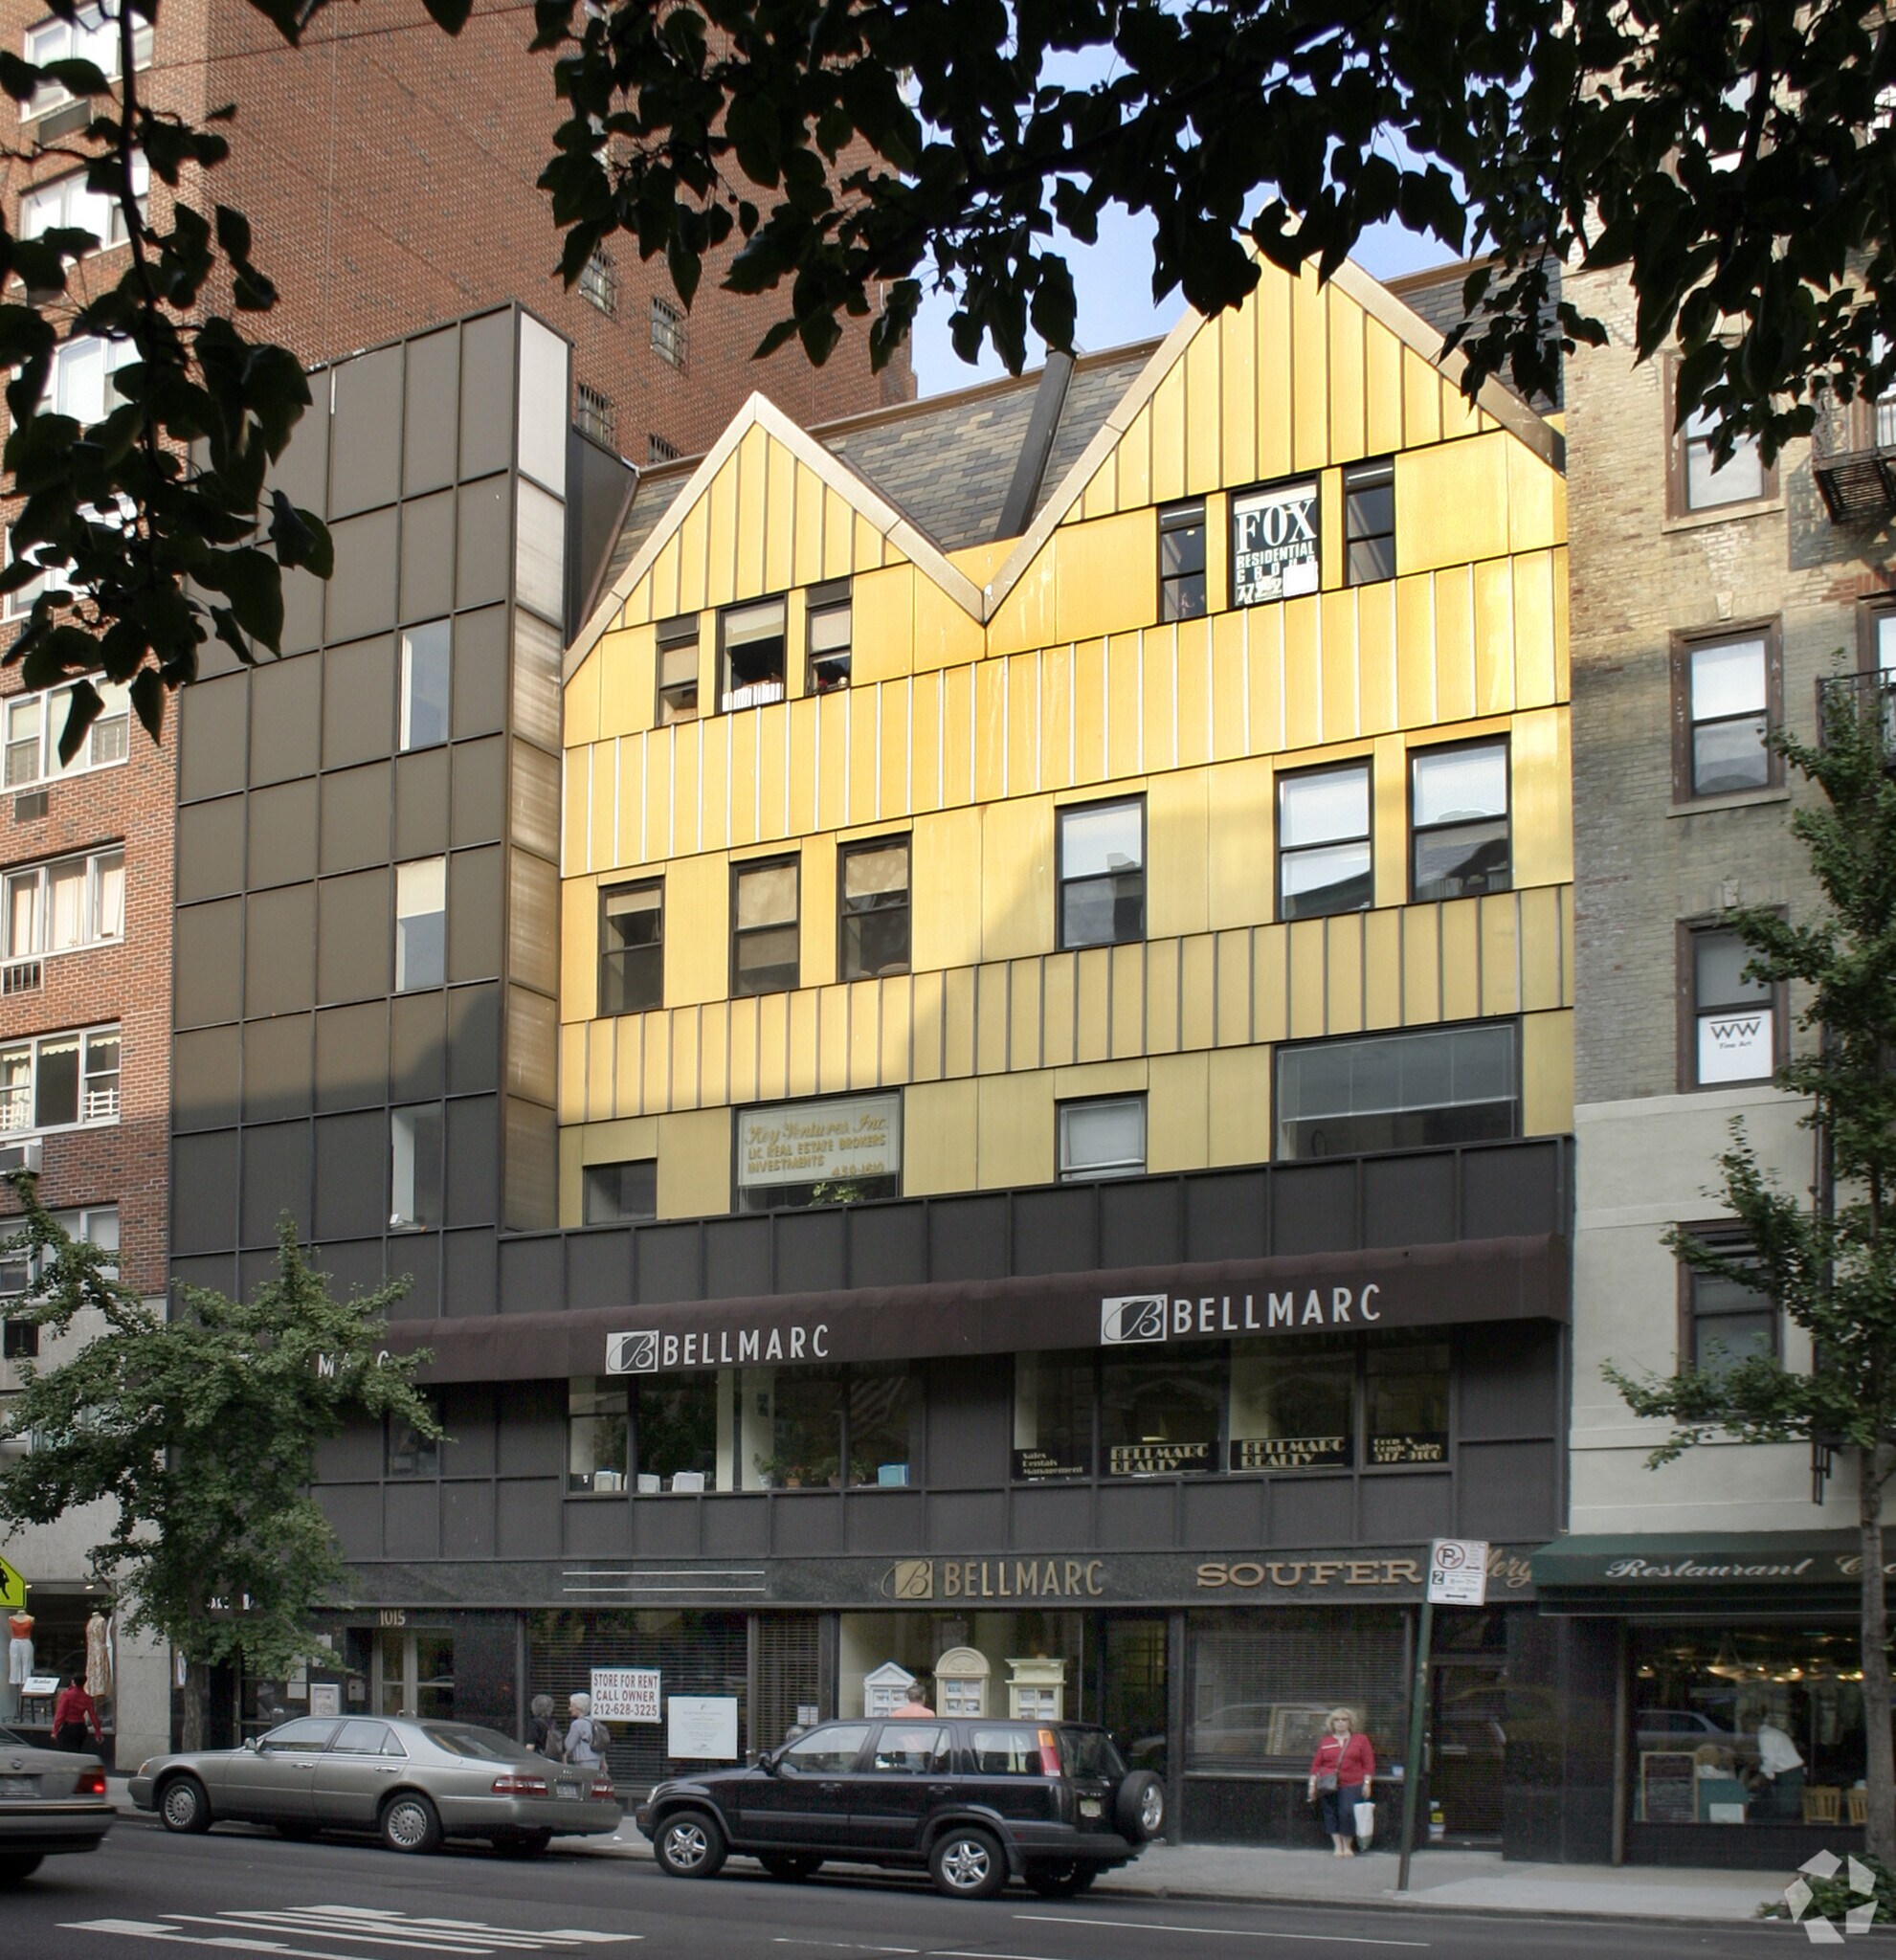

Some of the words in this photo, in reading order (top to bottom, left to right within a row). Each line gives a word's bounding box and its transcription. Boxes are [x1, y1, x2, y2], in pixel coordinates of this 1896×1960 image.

[1236, 499, 1318, 555] FOX
[1236, 541, 1315, 570] RESIDENTIAL
[1710, 1020, 1761, 1040] WW
[767, 1143, 792, 1158] REAL
[797, 1139, 835, 1155] ESTATE
[838, 1133, 887, 1151] BROKERS
[747, 1154, 825, 1174] INVESTMENTS
[1173, 1283, 1381, 1334] BELLMARC
[662, 1324, 829, 1367] BELLMARC
[1022, 1451, 1047, 1459] Sales
[1111, 1445, 1209, 1460] BELLMARC
[1242, 1438, 1345, 1455] BELLMARC
[1110, 1459, 1180, 1473] REALTY
[1241, 1453, 1316, 1468] REALTY
[1196, 1559, 1423, 1587] SOUFER
[1605, 1557, 1816, 1577] Restaurant
[944, 1561, 1104, 1596] BELLMARC
[379, 1609, 406, 1626] 1015
[593, 1673, 618, 1687] STORE
[621, 1674, 636, 1688] FOR
[638, 1675, 658, 1689] RENT
[596, 1690, 619, 1701] CALL
[622, 1690, 655, 1703] OWNER
[593, 1703, 658, 1717] 212-628-3225
